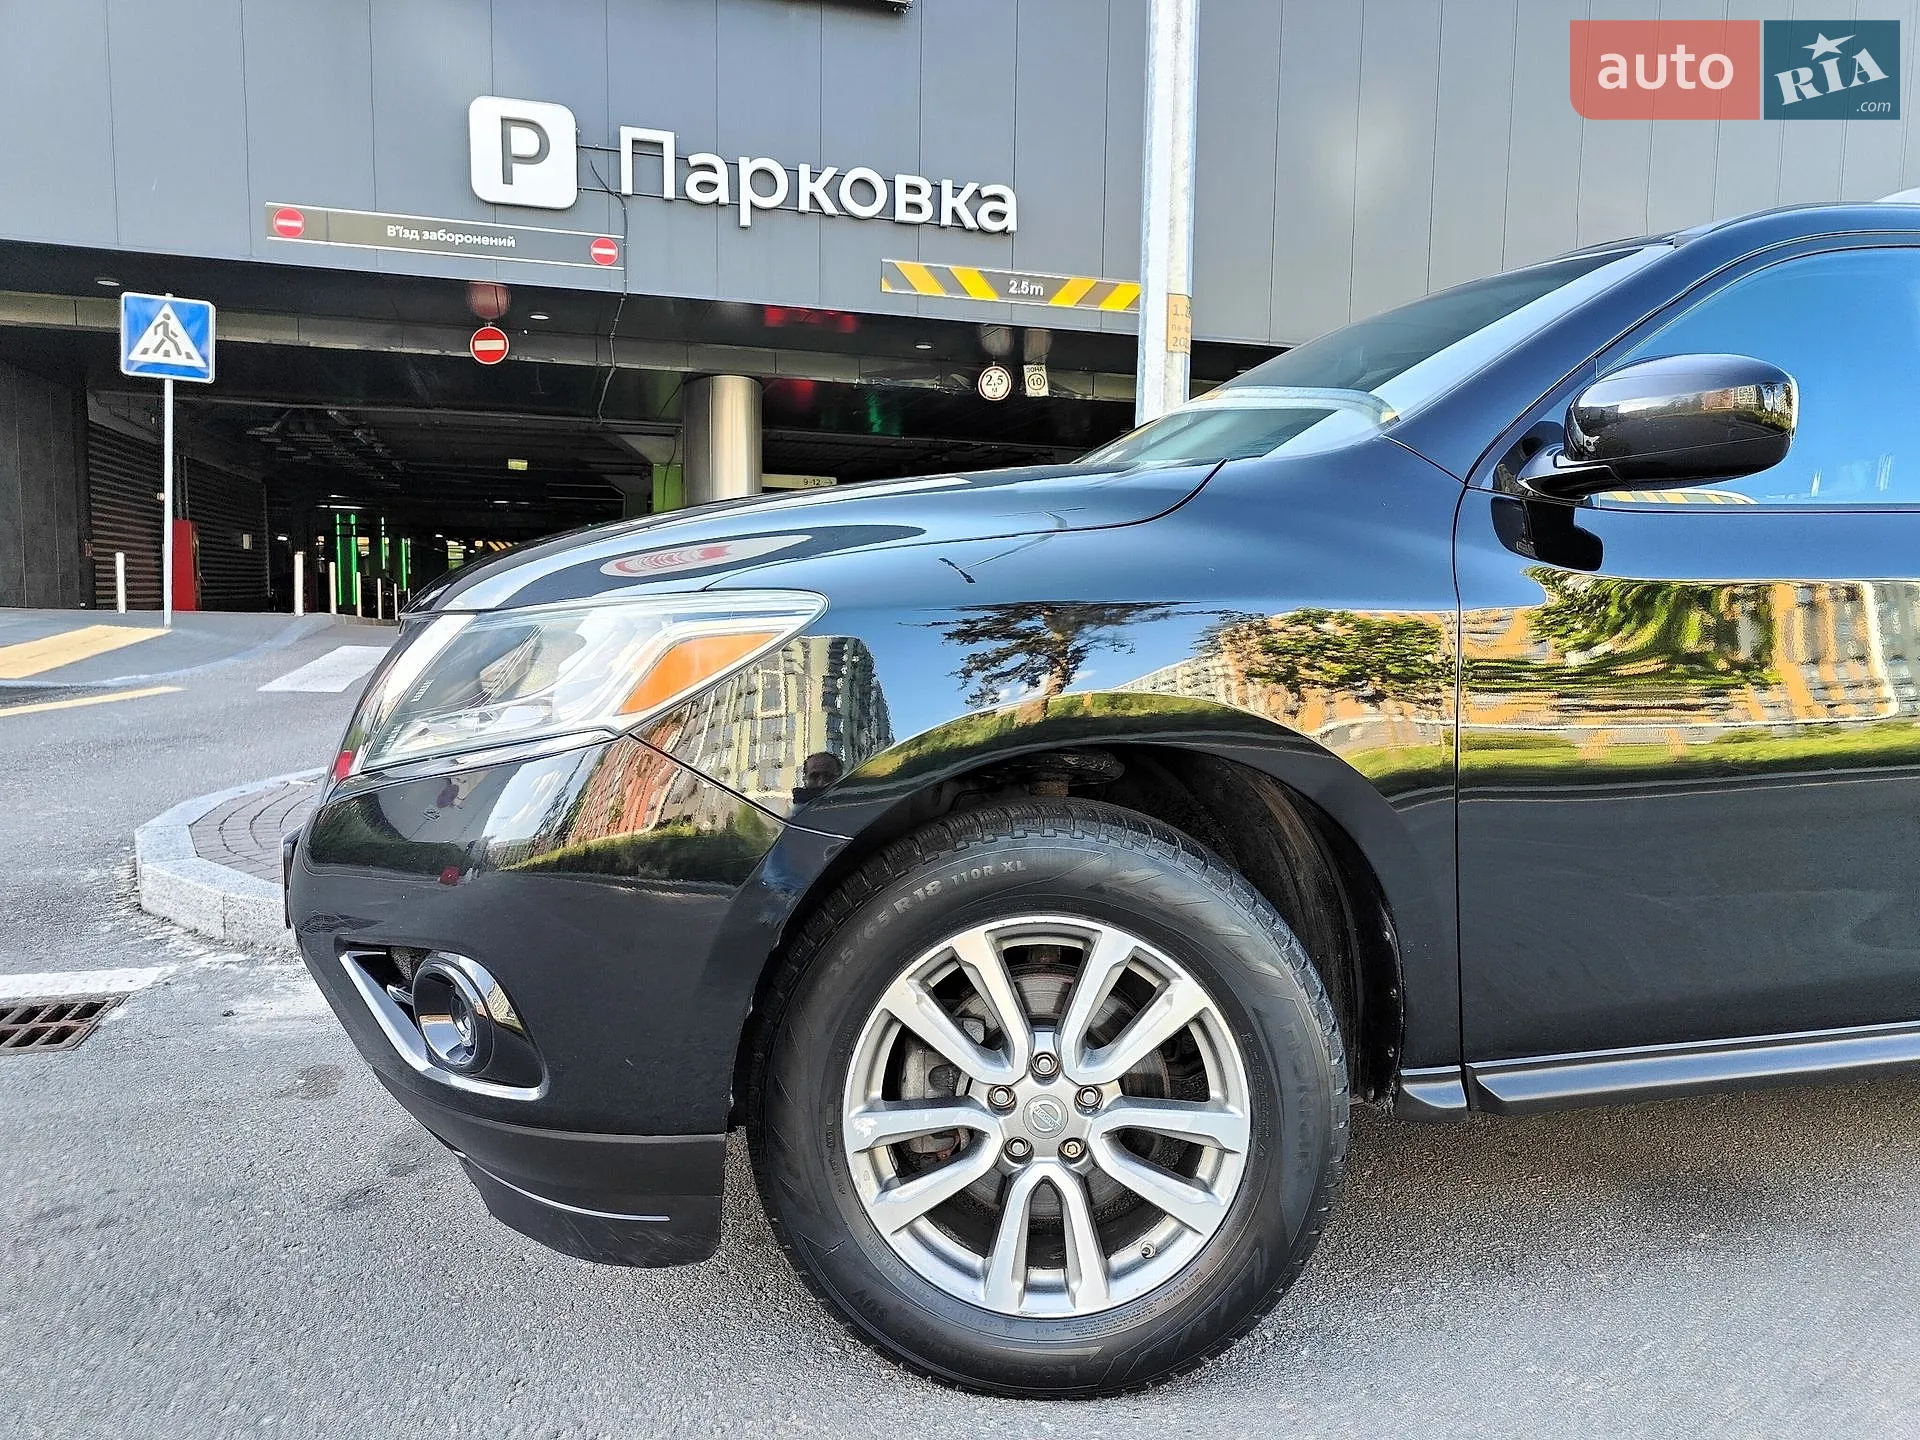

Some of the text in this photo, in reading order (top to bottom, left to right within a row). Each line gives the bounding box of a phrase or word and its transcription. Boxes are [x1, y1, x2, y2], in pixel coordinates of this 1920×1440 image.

[619, 125, 1018, 234] Парковка
[386, 224, 516, 248] В'їзд заборонений
[1008, 279, 1044, 296] 2.5m
[985, 374, 1004, 387] 2,5
[1031, 378, 1042, 386] 10
[803, 478, 820, 486] 9-12
[951, 865, 995, 887] 110R
[1001, 860, 1027, 874] XL
